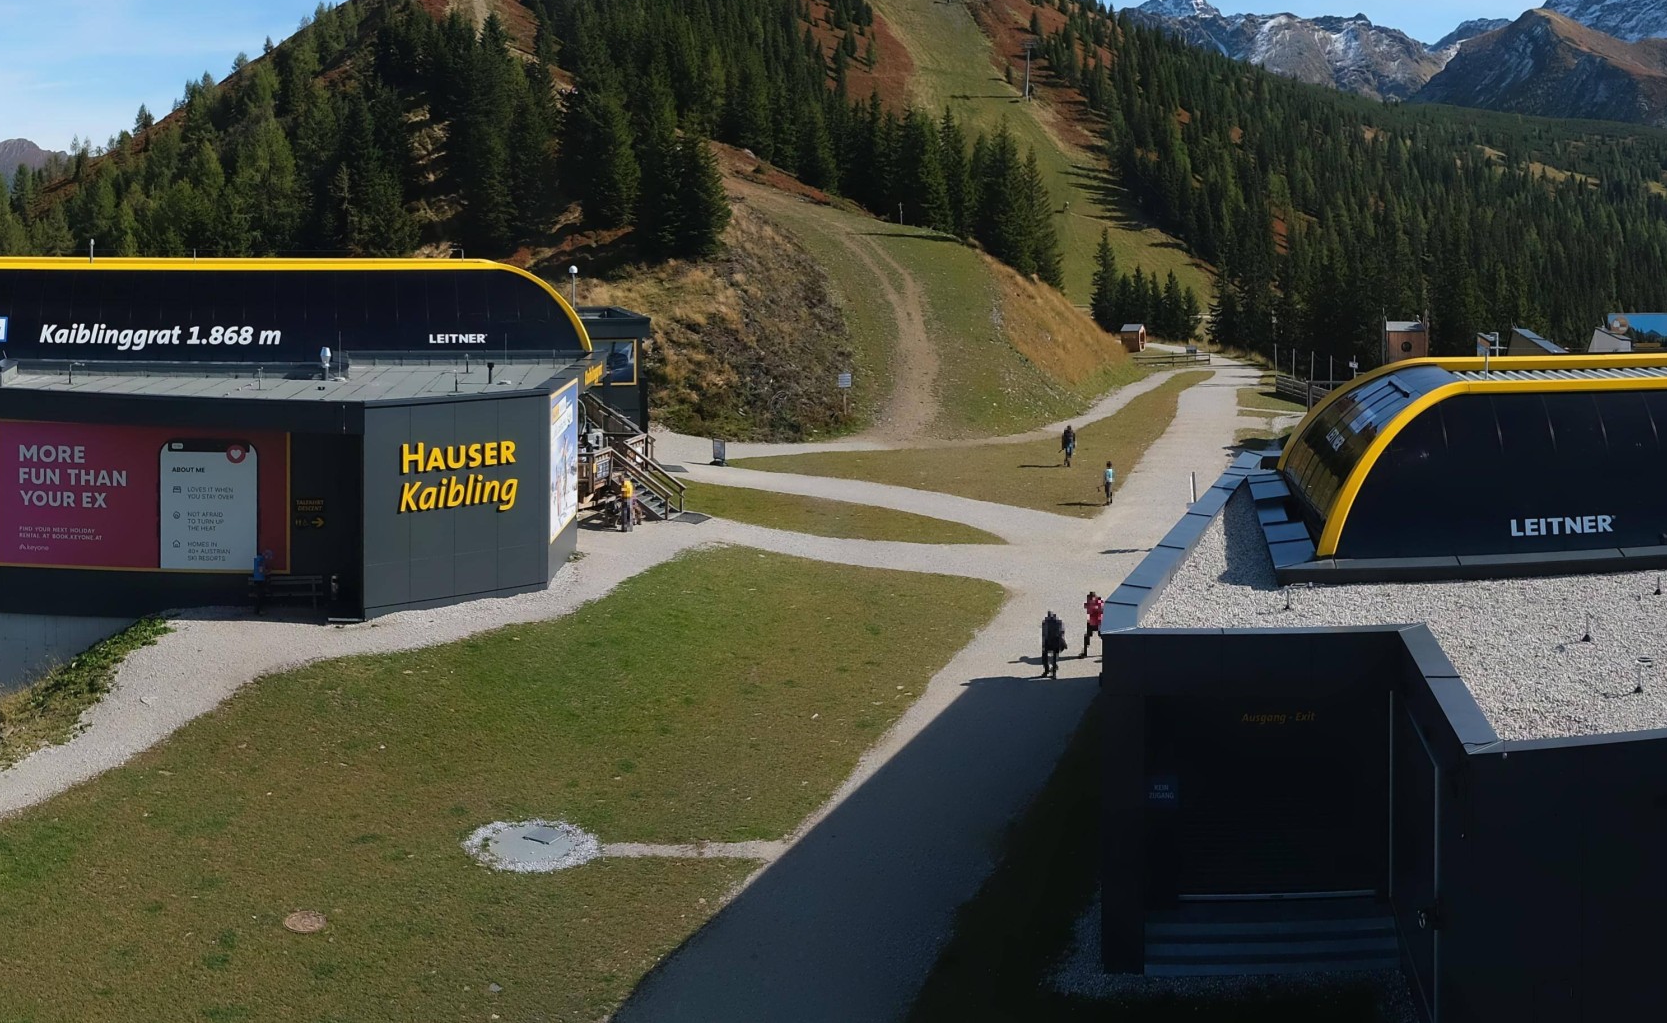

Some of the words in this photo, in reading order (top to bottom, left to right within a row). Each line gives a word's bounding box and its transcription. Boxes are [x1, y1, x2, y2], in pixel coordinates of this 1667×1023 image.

[39, 323, 182, 351] Kaiblinggrat
[187, 325, 254, 345] 1.868
[258, 330, 282, 345] m
[428, 333, 487, 344] LEITNER
[19, 444, 86, 463] MORE
[402, 440, 517, 474] HAUSER
[19, 467, 60, 485] FUN
[67, 469, 127, 487] THAN
[20, 490, 76, 507] YOUR
[82, 492, 108, 508] EX
[399, 474, 518, 513] Kaibling
[1510, 515, 1614, 536] LEITNER
[1241, 712, 1287, 725] Ausgang
[1295, 710, 1317, 722] Exit
